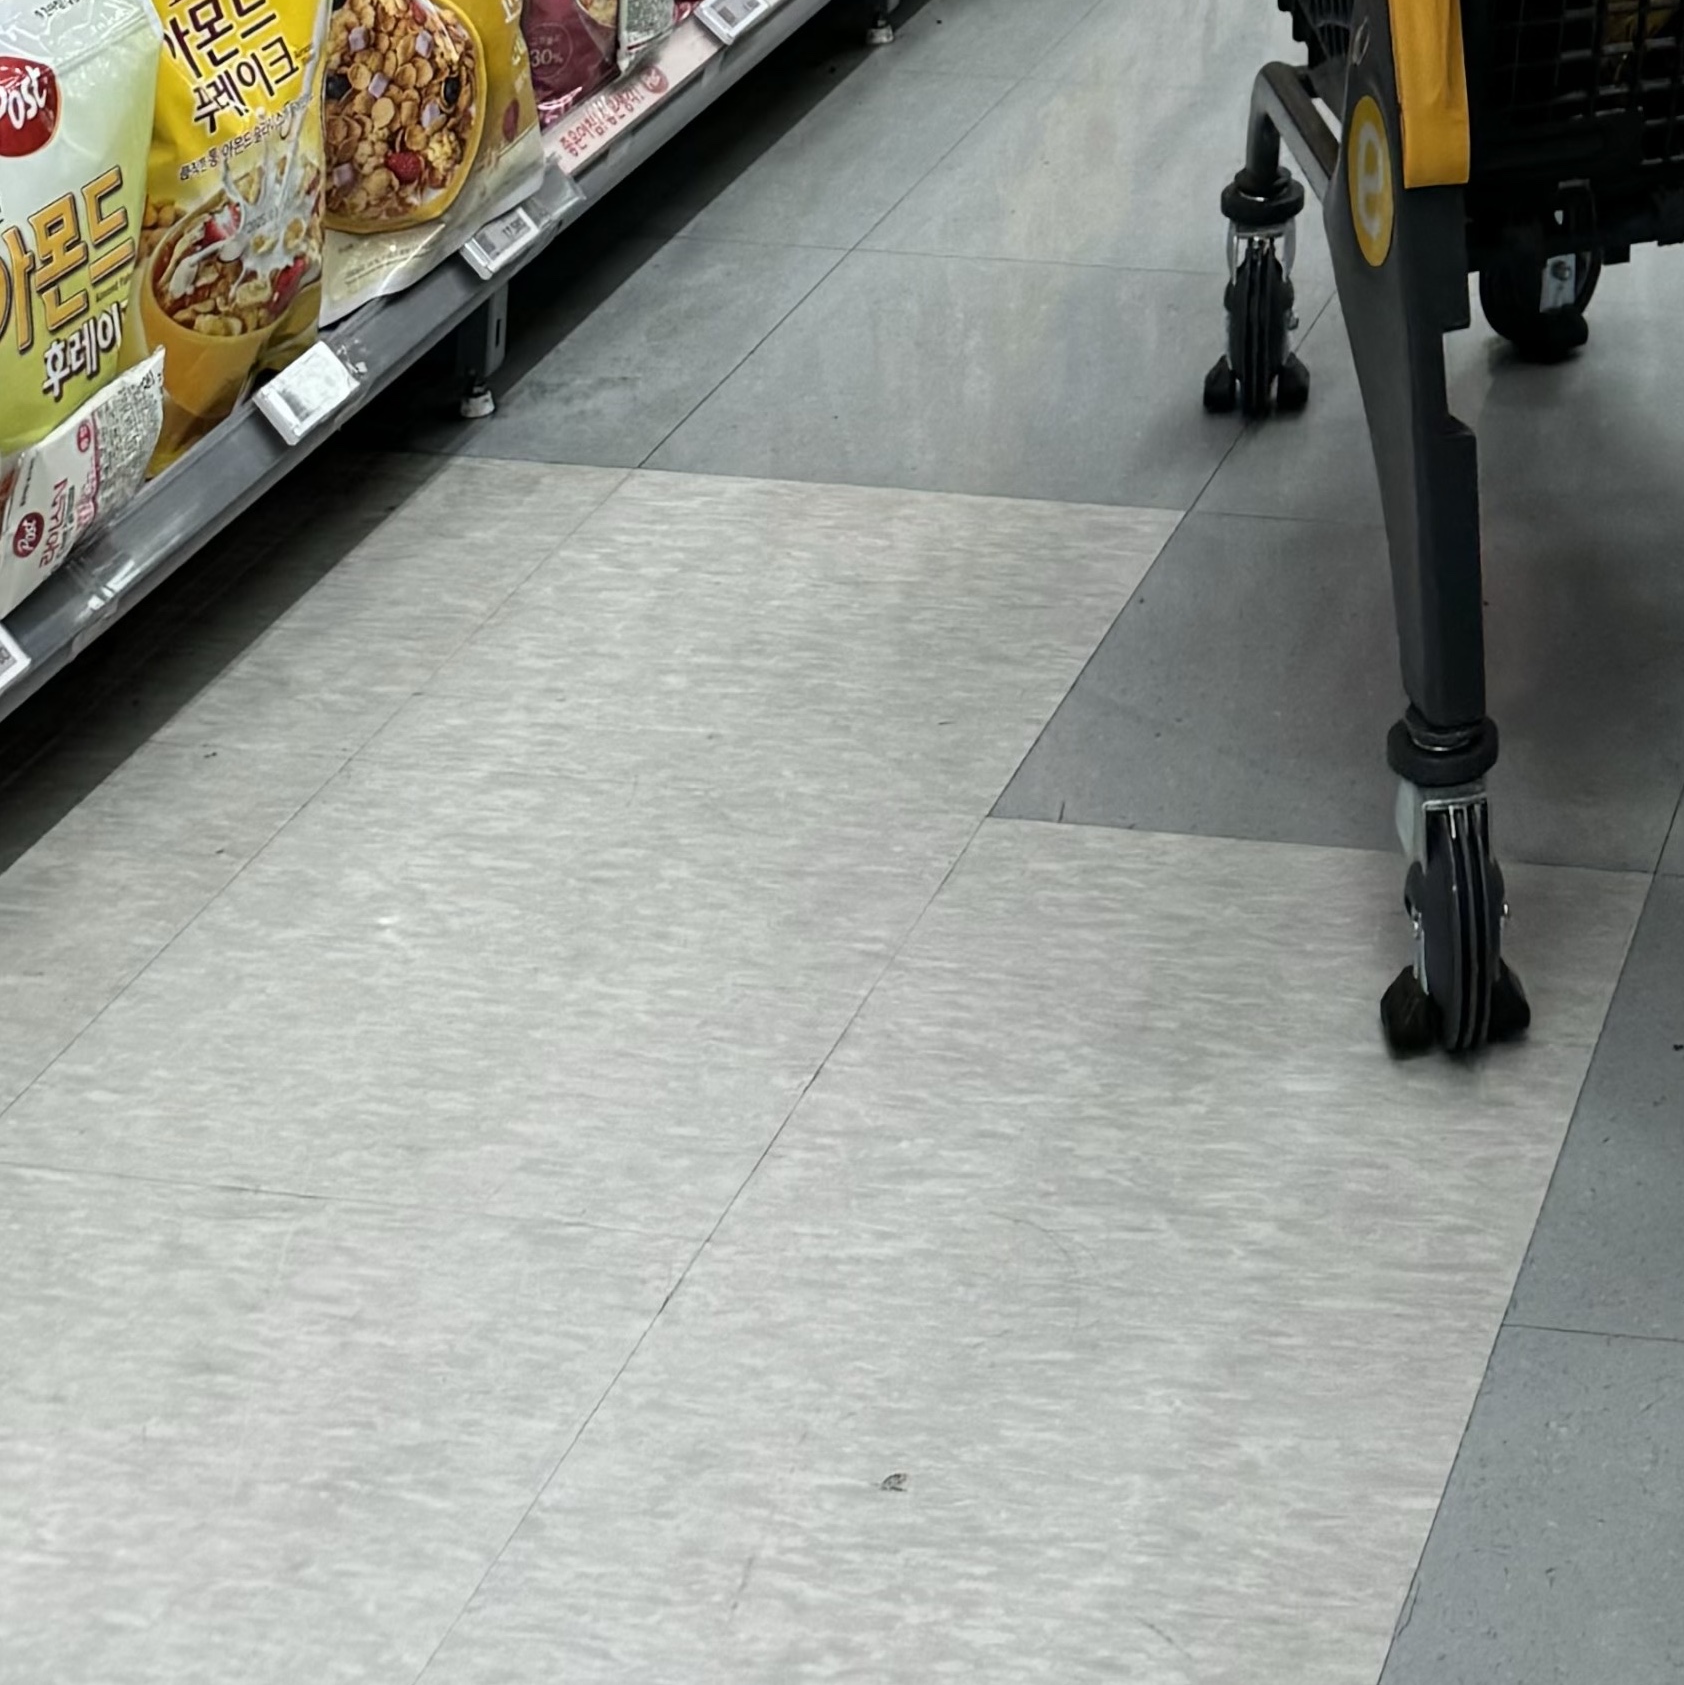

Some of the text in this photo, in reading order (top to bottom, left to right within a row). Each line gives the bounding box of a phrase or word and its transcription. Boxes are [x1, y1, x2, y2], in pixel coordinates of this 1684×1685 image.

[221, 132, 252, 162] 아몬드
[0, 165, 136, 353] 아몬드
[42, 299, 128, 401] 후레이
